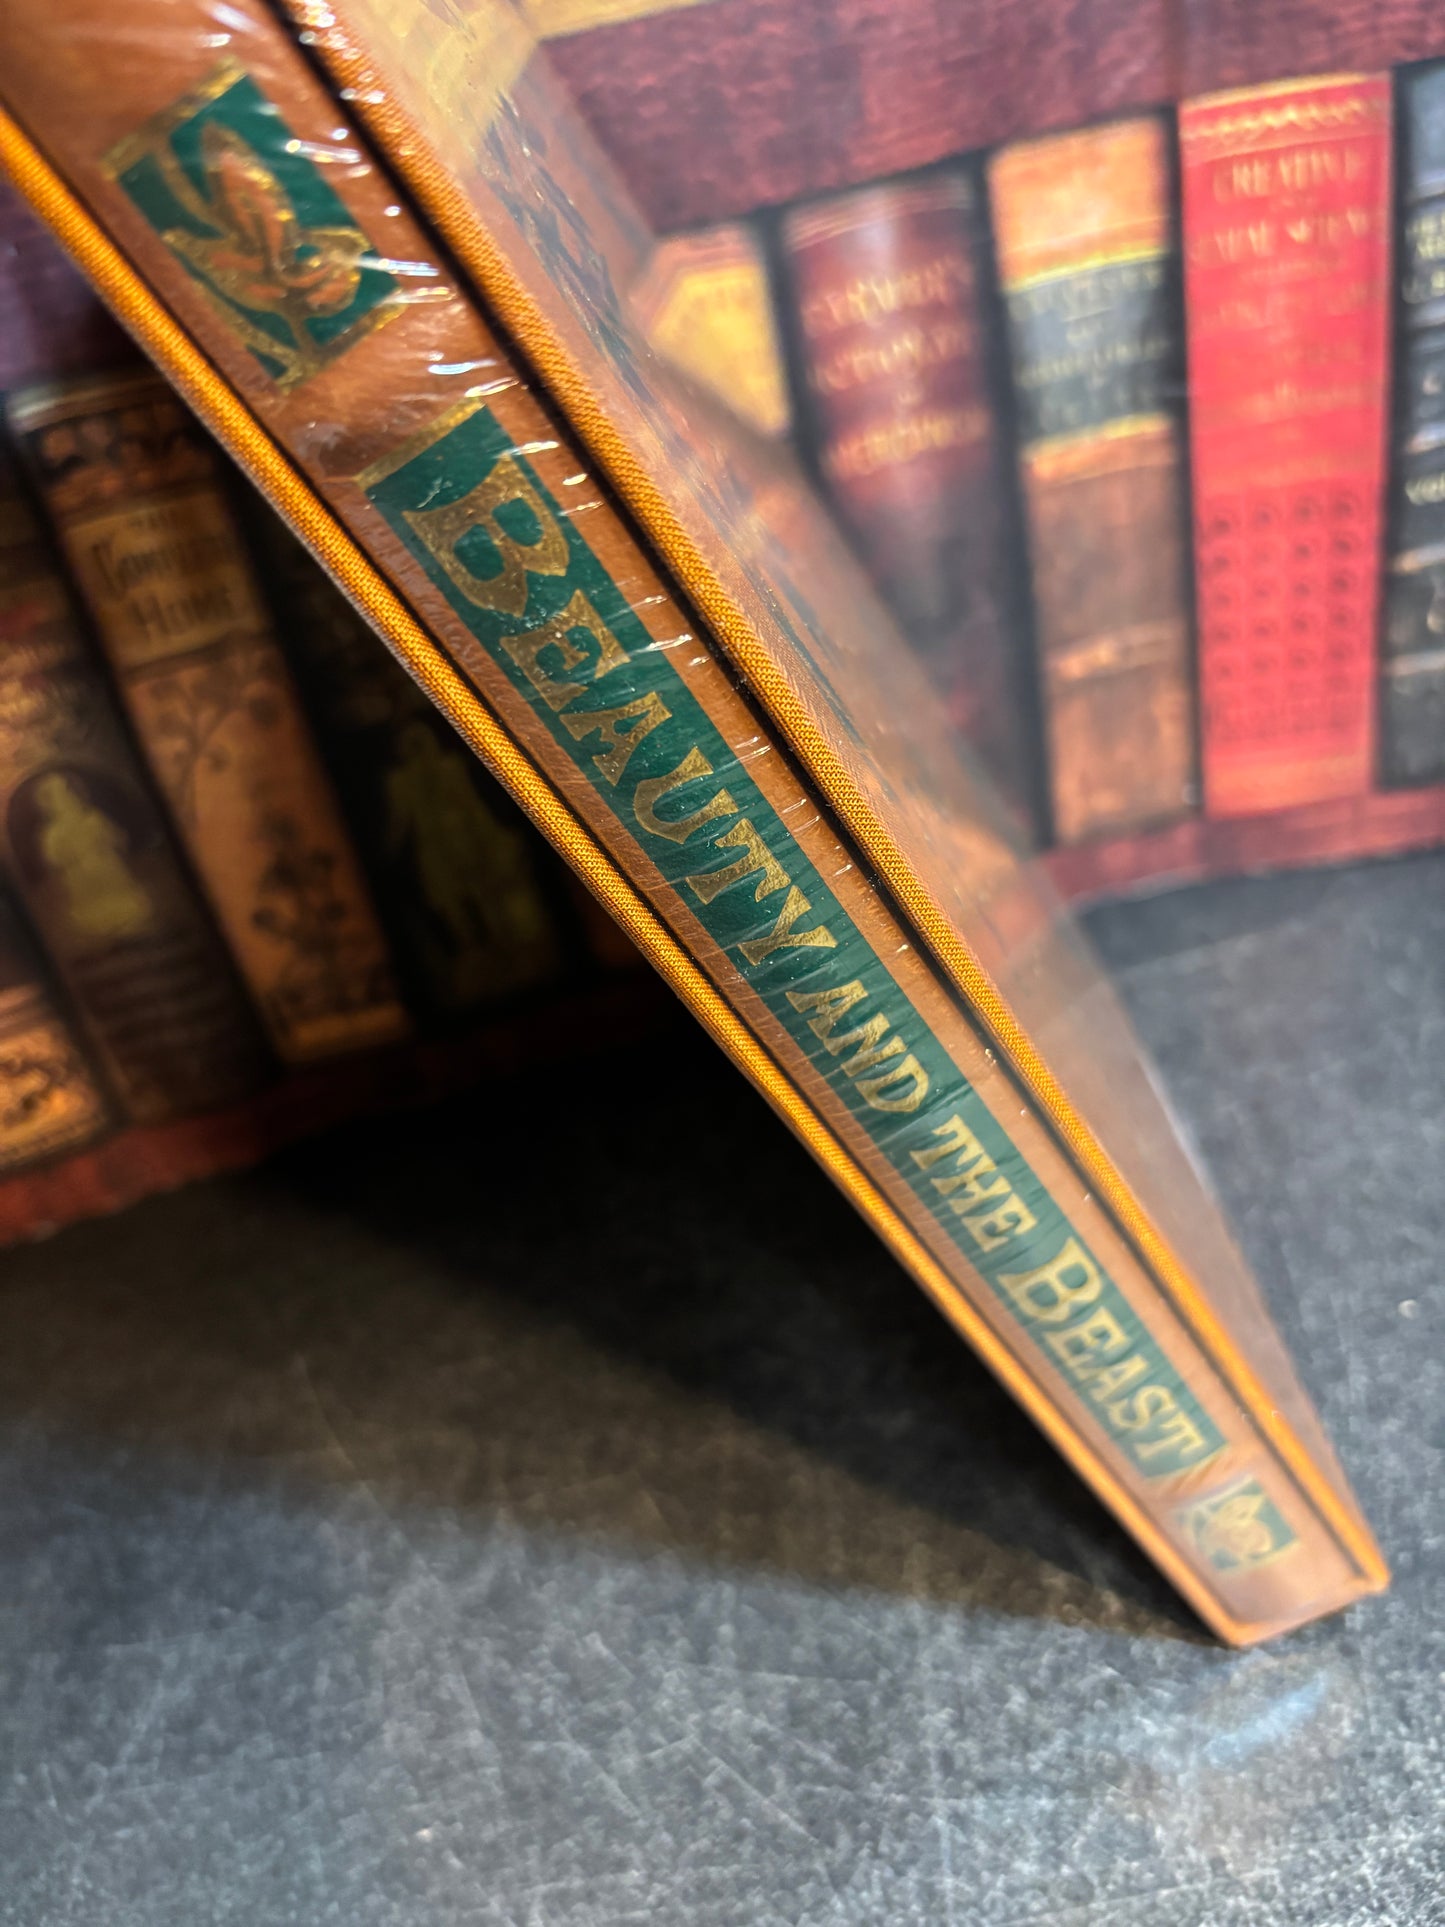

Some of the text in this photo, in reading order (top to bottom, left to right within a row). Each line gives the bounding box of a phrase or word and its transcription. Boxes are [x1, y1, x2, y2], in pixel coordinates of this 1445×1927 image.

[403, 452, 1208, 1461] BEAUTY AND THE BEAST
